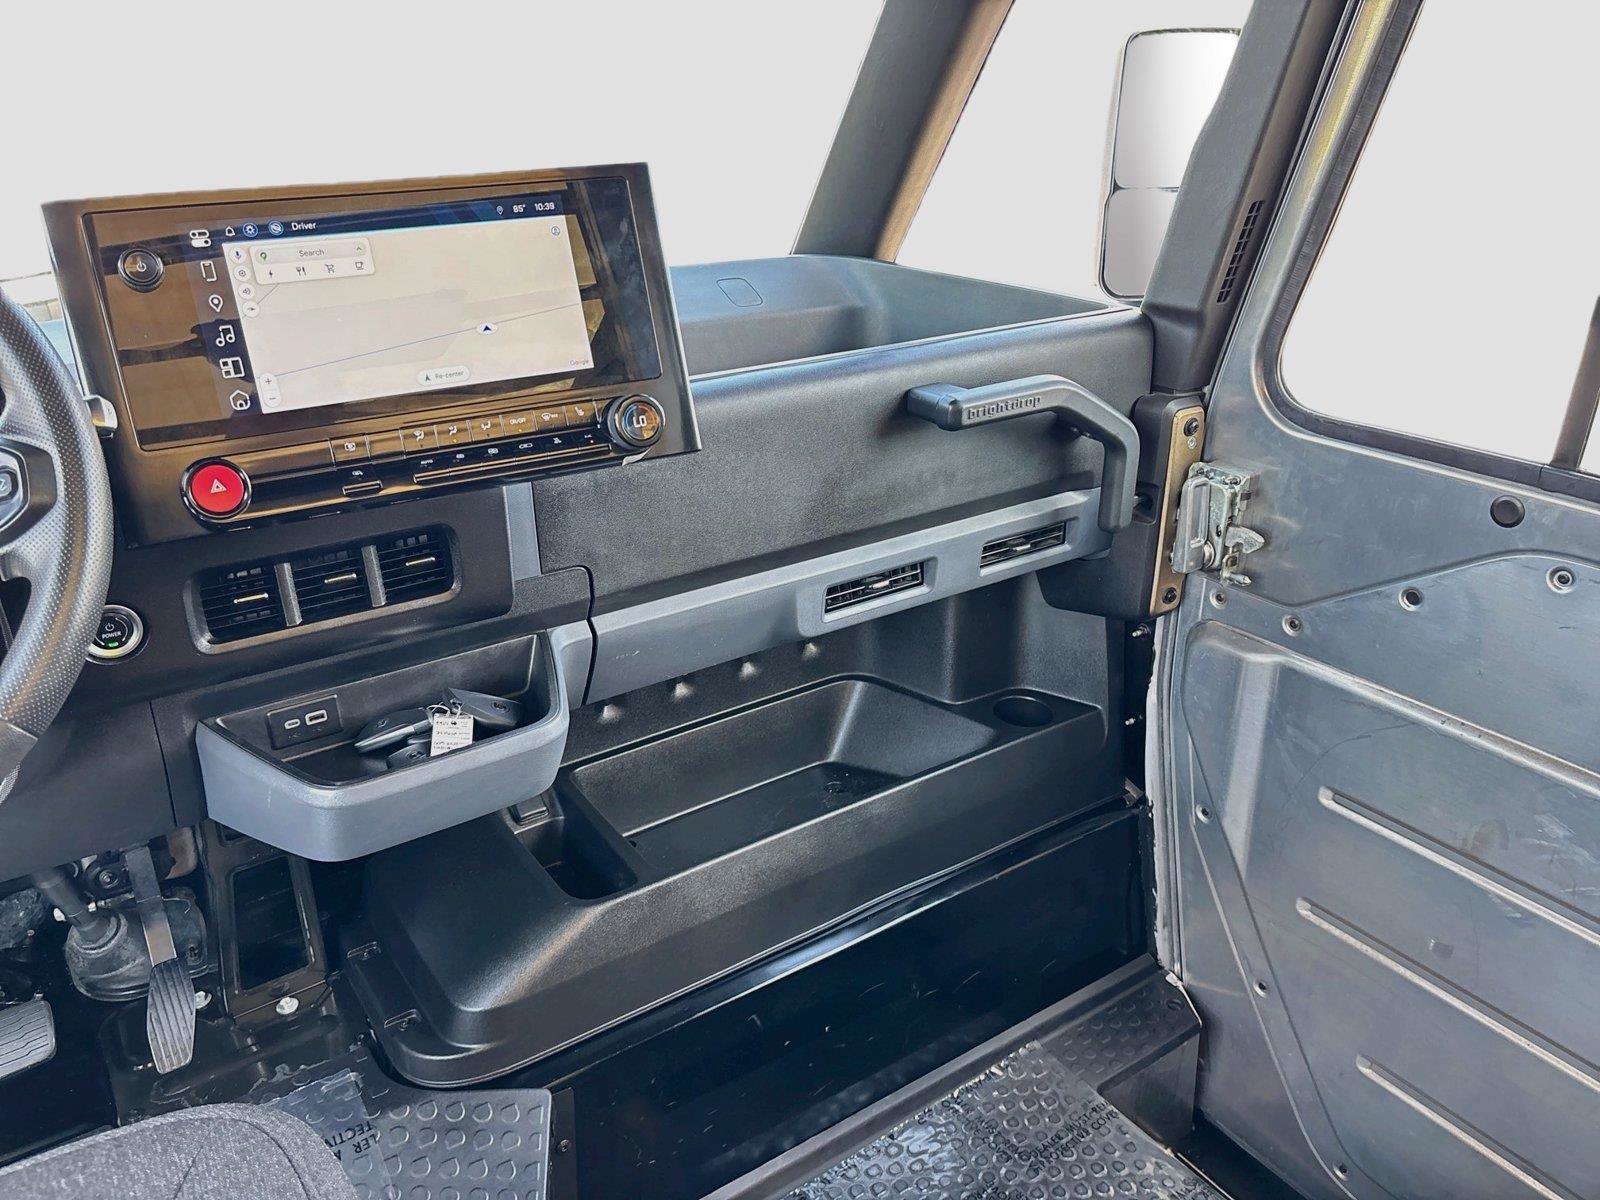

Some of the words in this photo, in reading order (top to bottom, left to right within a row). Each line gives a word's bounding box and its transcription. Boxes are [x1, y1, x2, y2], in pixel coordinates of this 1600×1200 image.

[534, 202, 555, 211] 10:39
[291, 222, 317, 231] Driver
[299, 249, 325, 258] Search
[967, 395, 1041, 421] brightdrop
[101, 630, 121, 639] POWER
